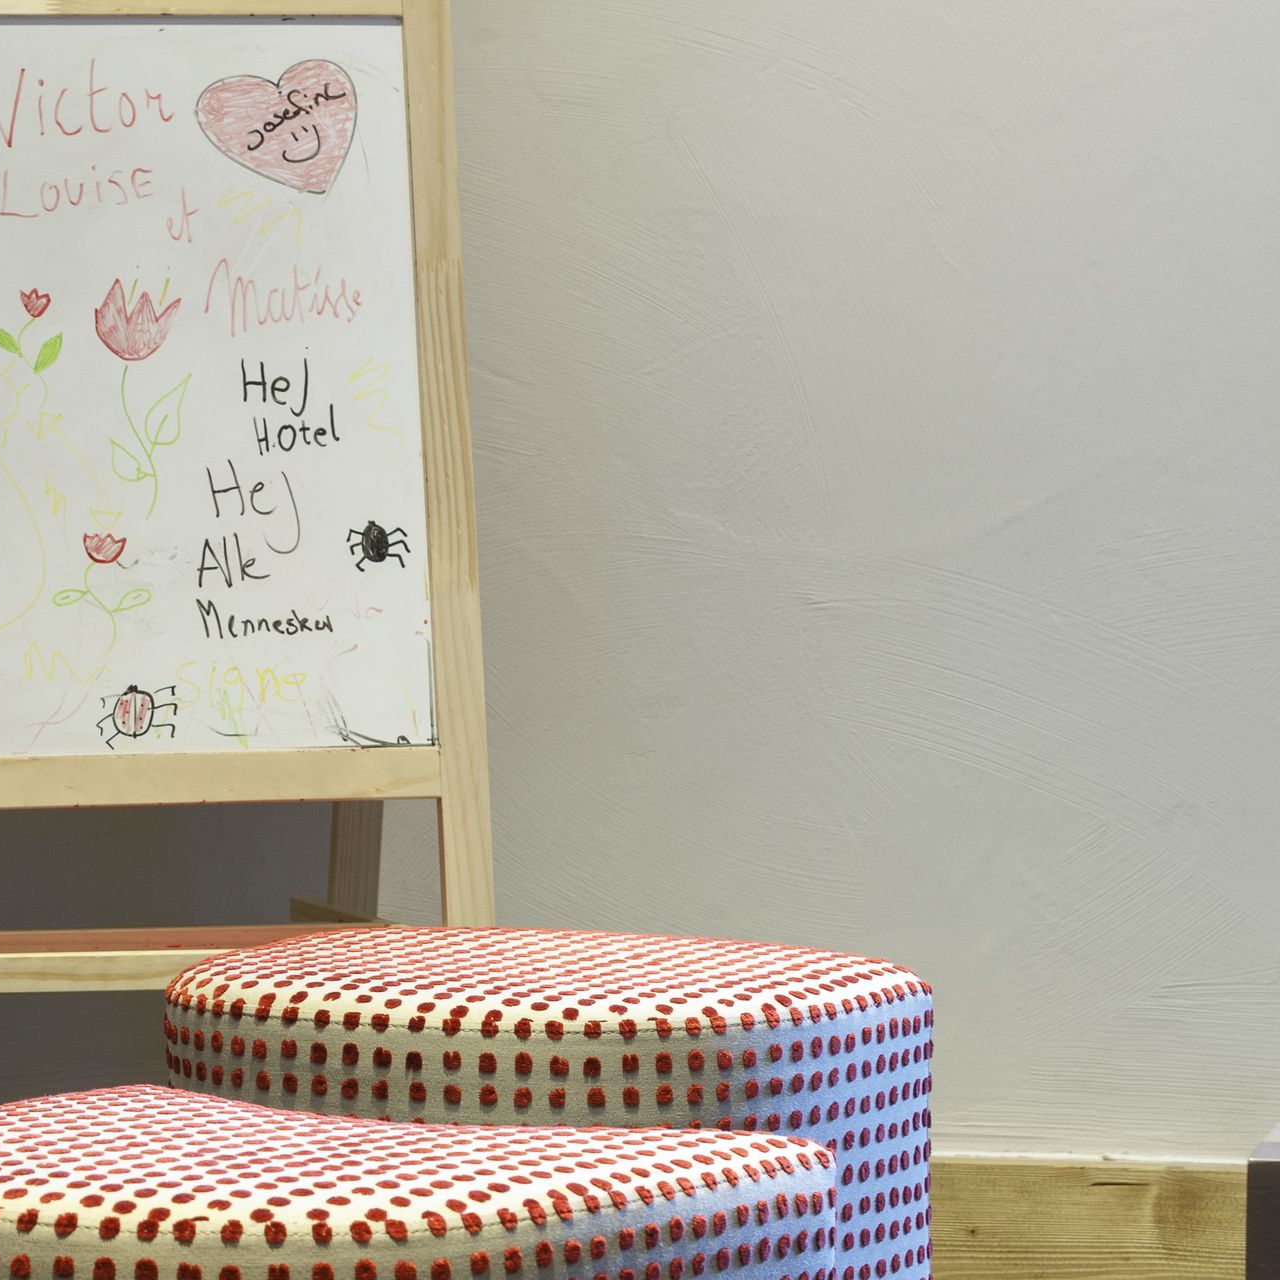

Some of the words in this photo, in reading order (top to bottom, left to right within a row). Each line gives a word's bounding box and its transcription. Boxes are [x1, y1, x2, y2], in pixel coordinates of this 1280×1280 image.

[166, 186, 200, 243] et
[240, 346, 309, 417] Hej
[206, 459, 301, 555] Hej
